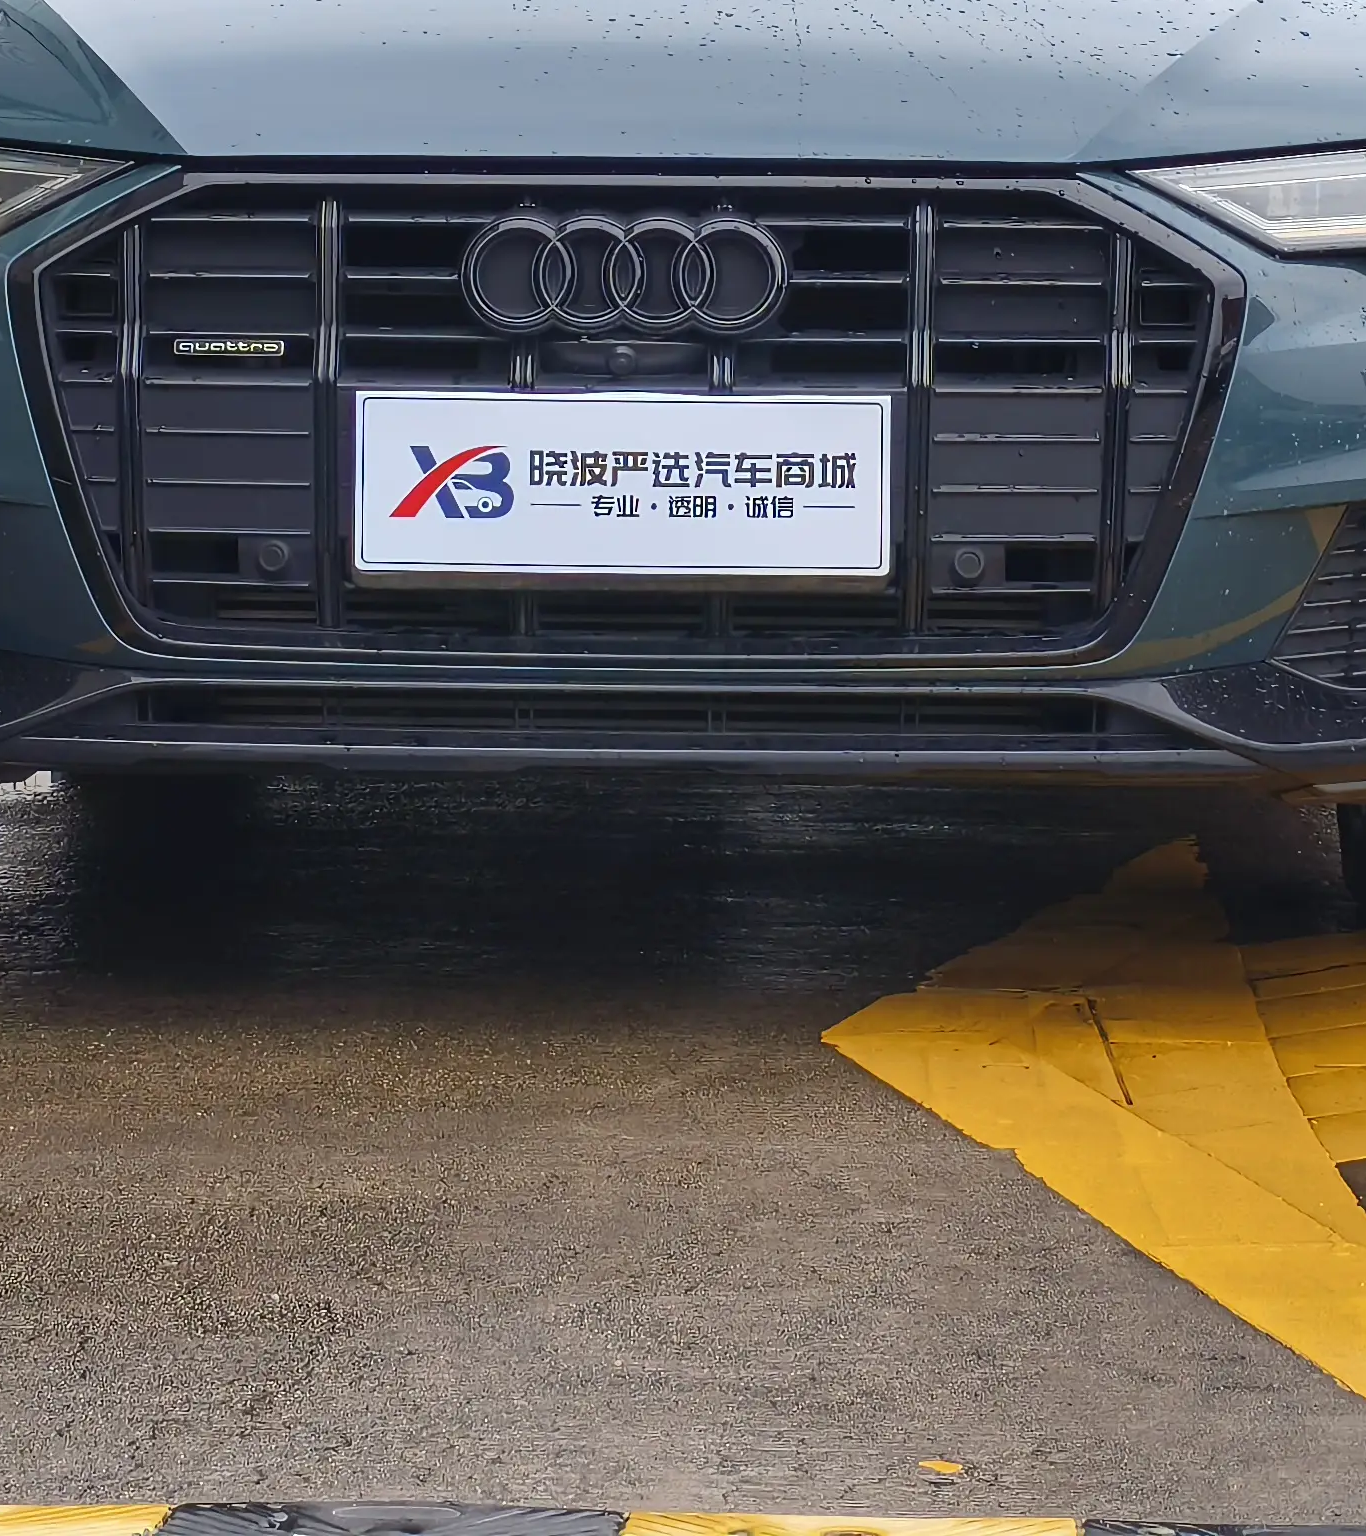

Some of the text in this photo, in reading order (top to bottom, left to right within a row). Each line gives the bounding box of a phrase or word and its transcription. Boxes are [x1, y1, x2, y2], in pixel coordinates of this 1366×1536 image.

[179, 341, 279, 354] quattro
[529, 449, 857, 490] 晓波严选汽车商城
